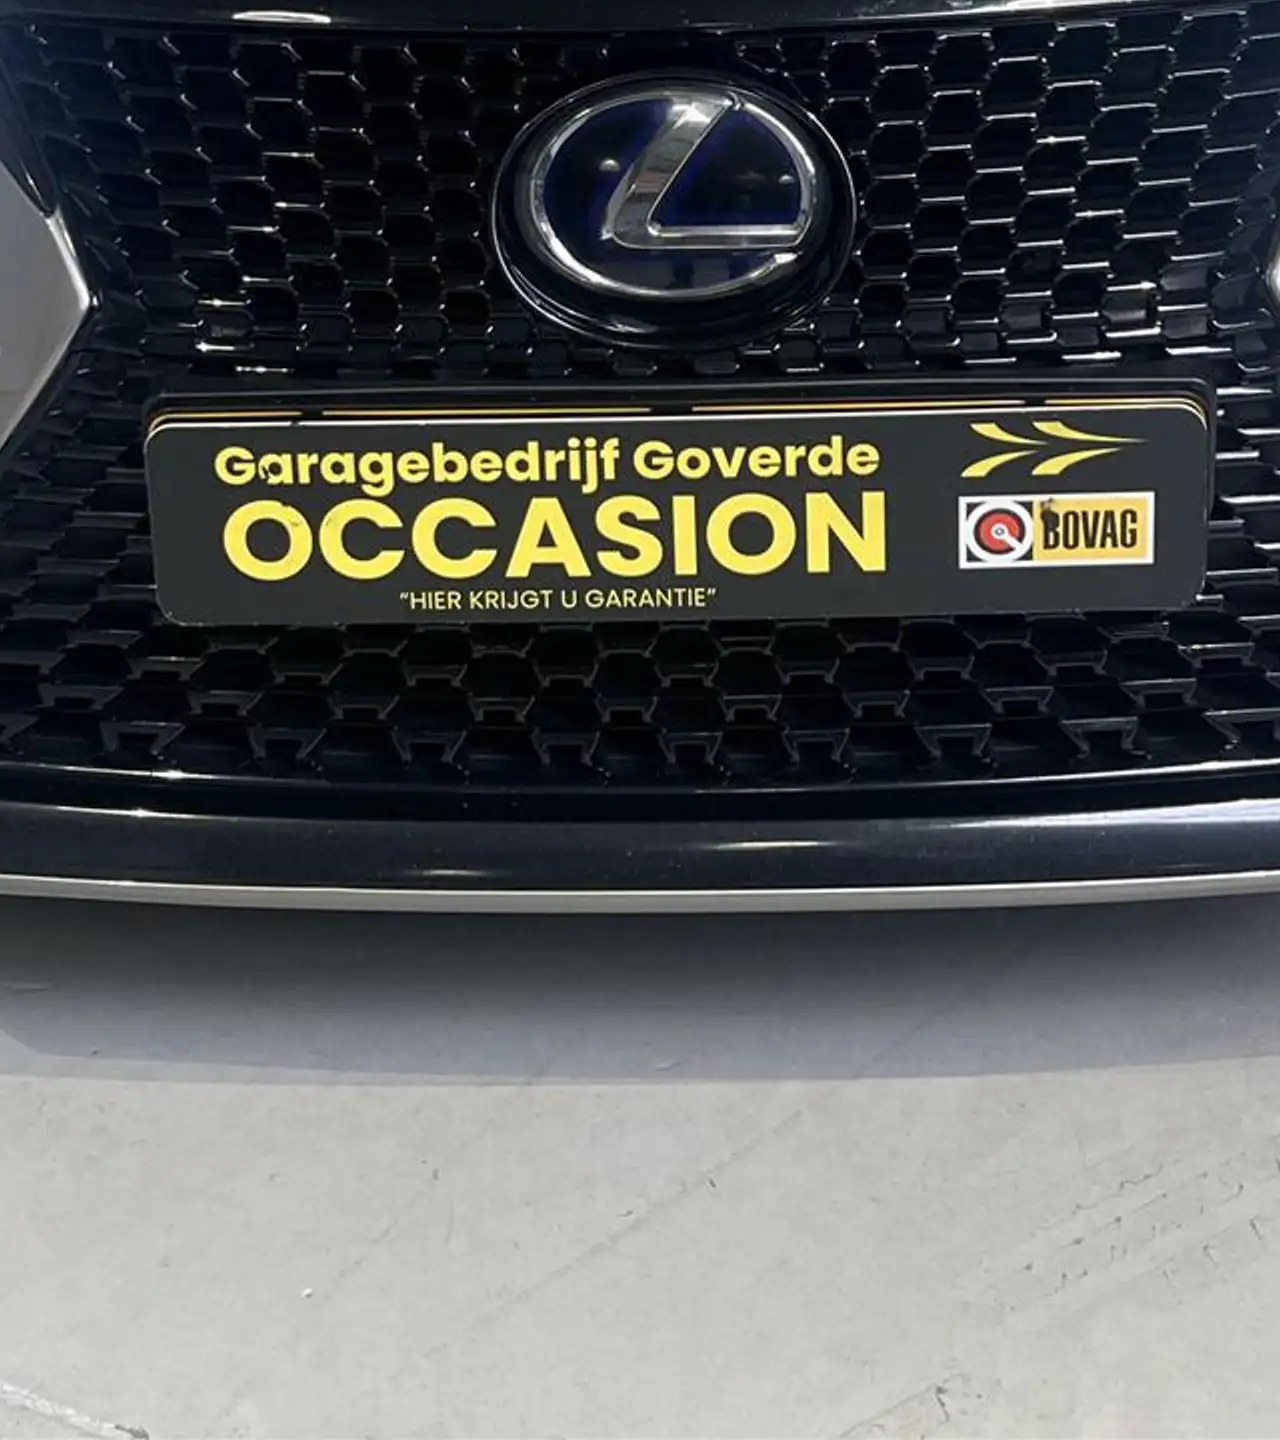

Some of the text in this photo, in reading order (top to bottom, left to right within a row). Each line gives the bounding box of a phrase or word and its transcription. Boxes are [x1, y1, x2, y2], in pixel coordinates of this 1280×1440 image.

[214, 434, 880, 498] Garagebedrijf Goverde
[223, 490, 886, 581] OCCASION
[1041, 508, 1138, 550] BOVAG
[468, 590, 552, 609] KRIJGT
[561, 589, 578, 608] U
